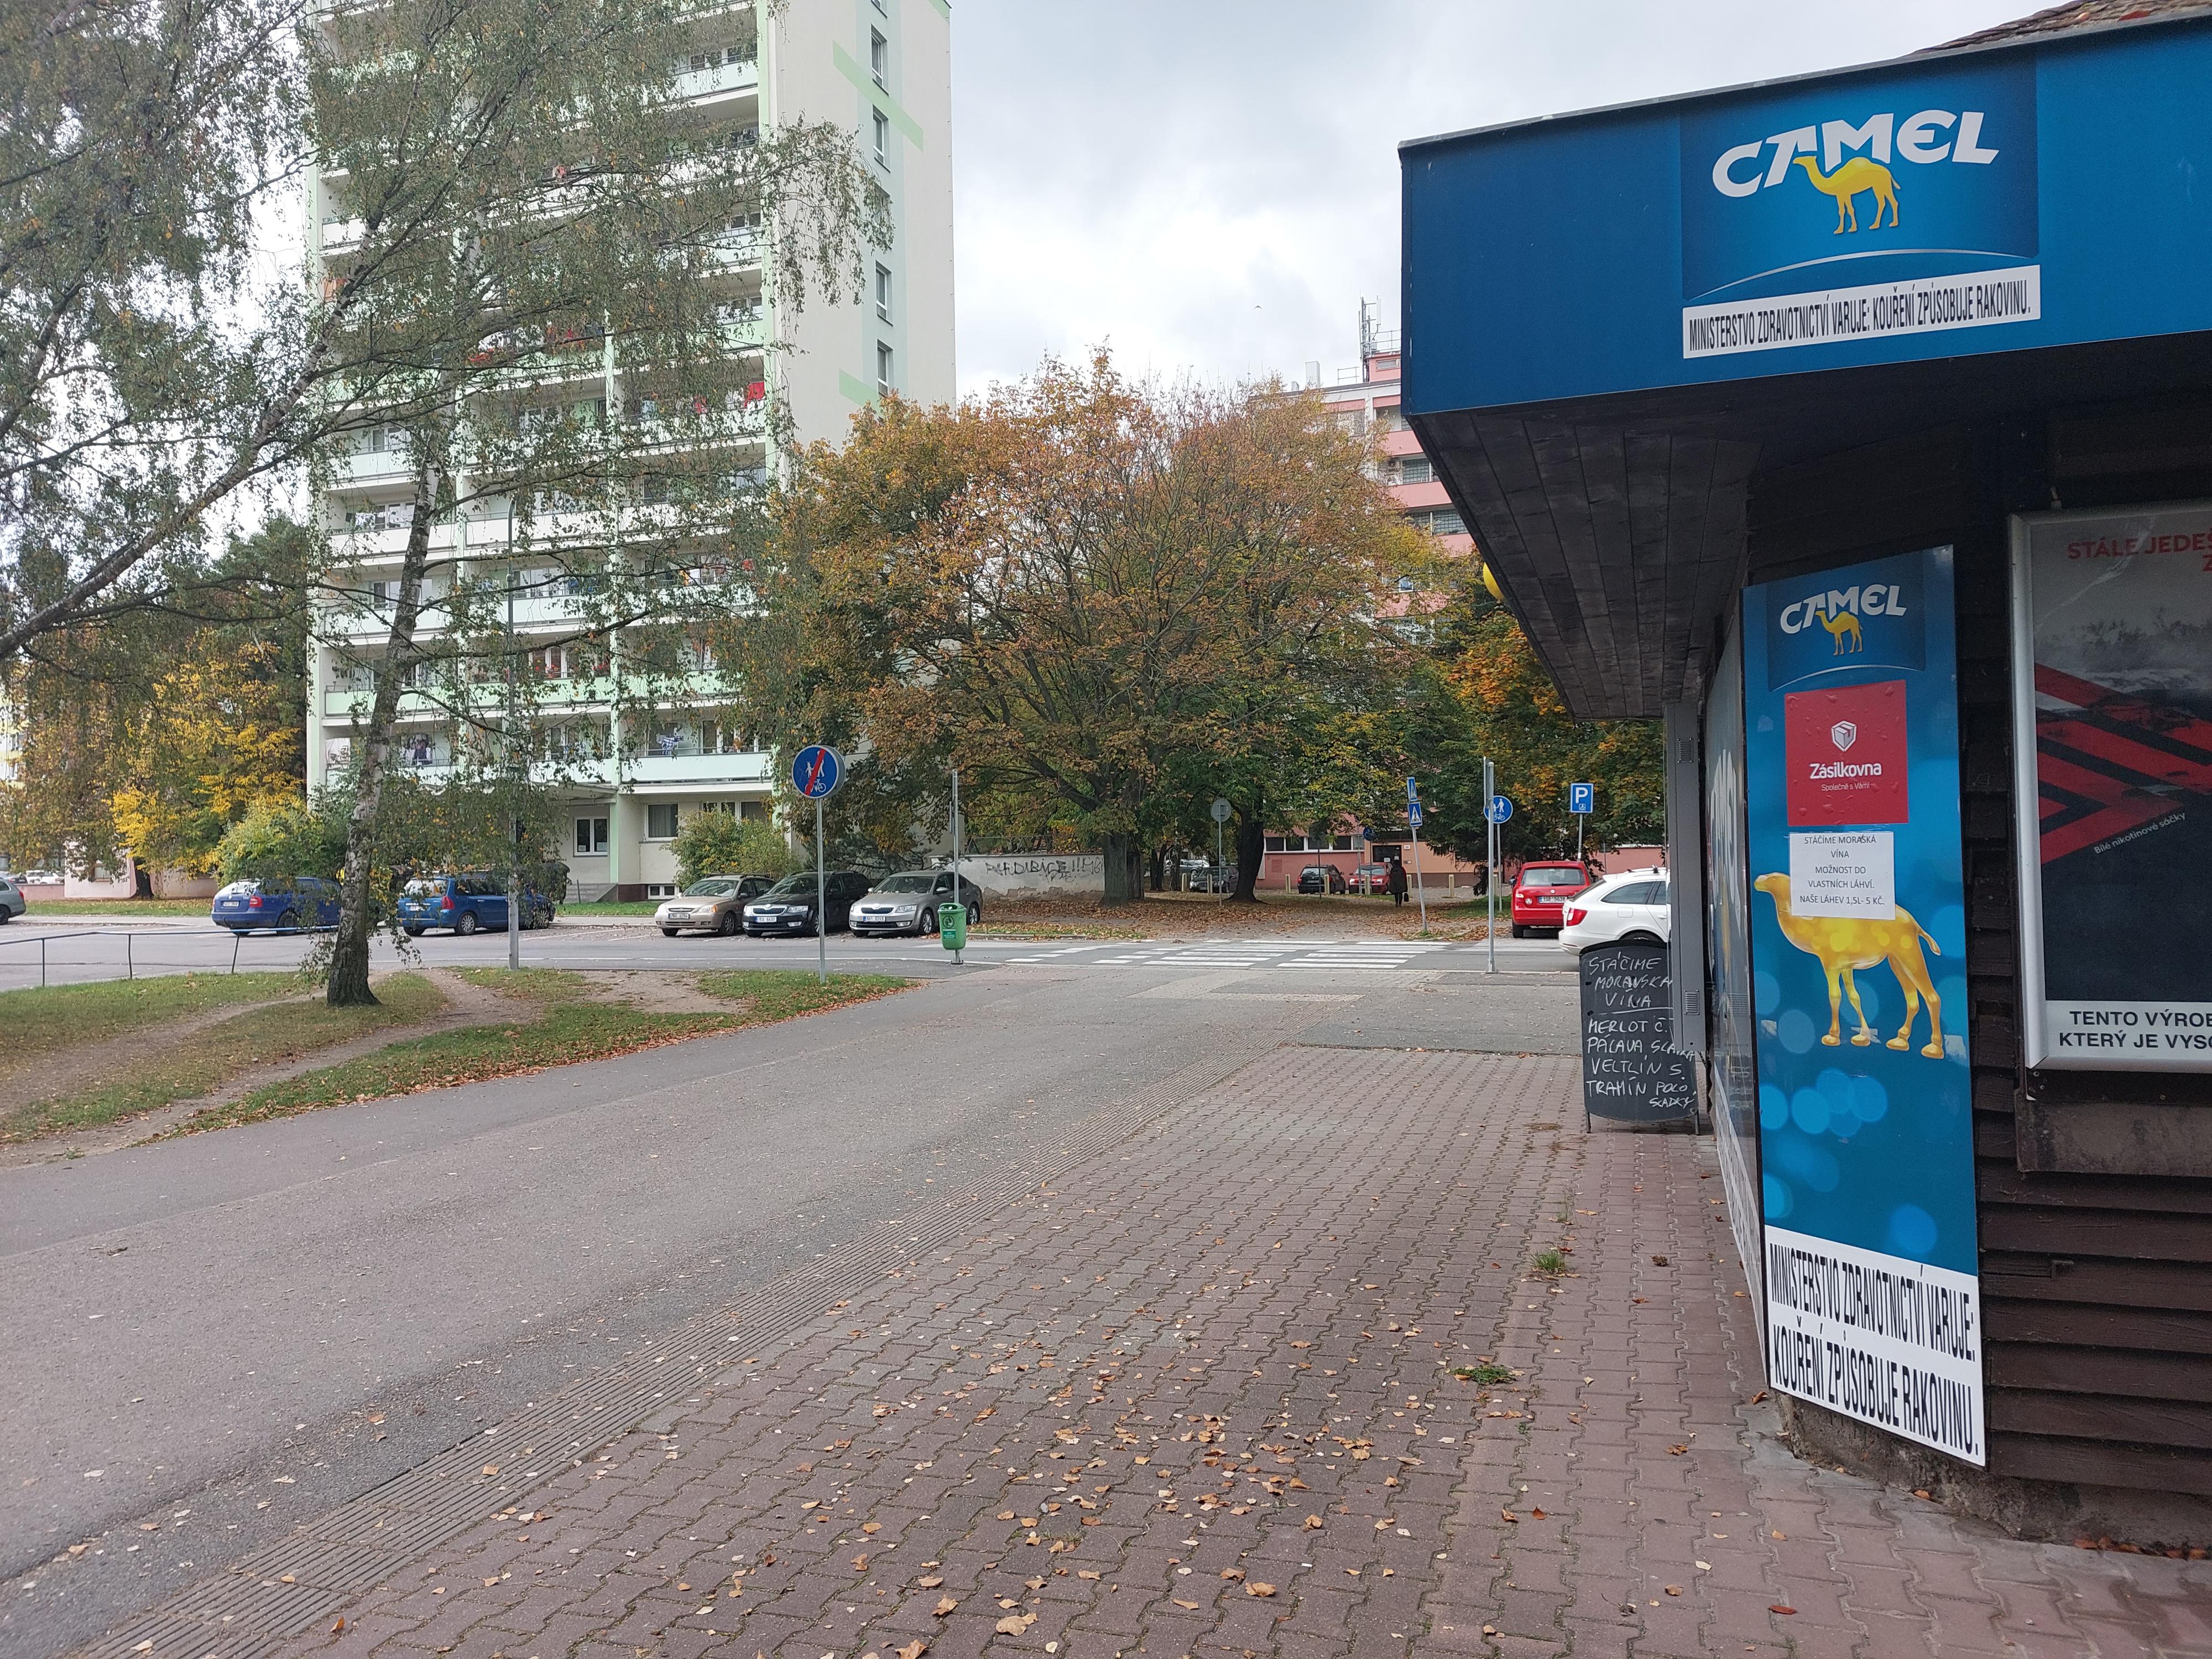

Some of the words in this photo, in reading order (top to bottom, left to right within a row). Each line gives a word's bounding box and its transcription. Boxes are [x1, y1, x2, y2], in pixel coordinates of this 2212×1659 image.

[1712, 109, 2000, 197] CAMEL
[1689, 311, 1755, 351] MINISTERSTVO
[1757, 294, 1830, 343] ZDRAVOTNICTVÍ
[1832, 298, 1870, 335] VARUJE:
[1873, 283, 1915, 331] KOUŘENÍ
[1917, 281, 1974, 325] ZPŮSOBUJE
[1976, 279, 2031, 319] RAKOVINU.
[1780, 584, 1907, 634] CAMEL
[1809, 761, 1882, 779] Zásilkovna
[1575, 787, 1588, 804] P
[1822, 783, 1849, 791] Společně
[2111, 822, 2159, 847] nikotinové
[2159, 812, 2185, 828] sáčky
[1804, 835, 1836, 844] STÁČÍME
[1830, 848, 1850, 858] VÍNA
[1815, 864, 1853, 874] MOŽNOST
[1808, 879, 1848, 888] VLASTNÍCH
[1850, 879, 1875, 889] LÁHVÍ.
[1800, 894, 1818, 903] NAŠE
[1820, 894, 1844, 904] LÁHEV
[1588, 1018, 1648, 1034] MERLOT
[2069, 1011, 2138, 1026] TENTO
[1587, 1034, 1642, 1054] PÁLAVA
[2059, 1030, 2127, 1047] KTERÝ
[2133, 1034, 2158, 1048] JE
[1592, 1055, 1662, 1075] VELTLÍN
[1585, 1077, 1646, 1097] TRAMÍN
[1770, 1243, 1840, 1322] MINISTERSTVO
[1843, 1264, 1925, 1347] ZDRAVOTNICTVÍ
[1926, 1283, 1976, 1362] VARUJE:
[1773, 1315, 1824, 1400] KOUŘENÍ
[1827, 1330, 1899, 1427] ZPŮSOBUJE
[1902, 1365, 1979, 1455] RAKOVINU.
